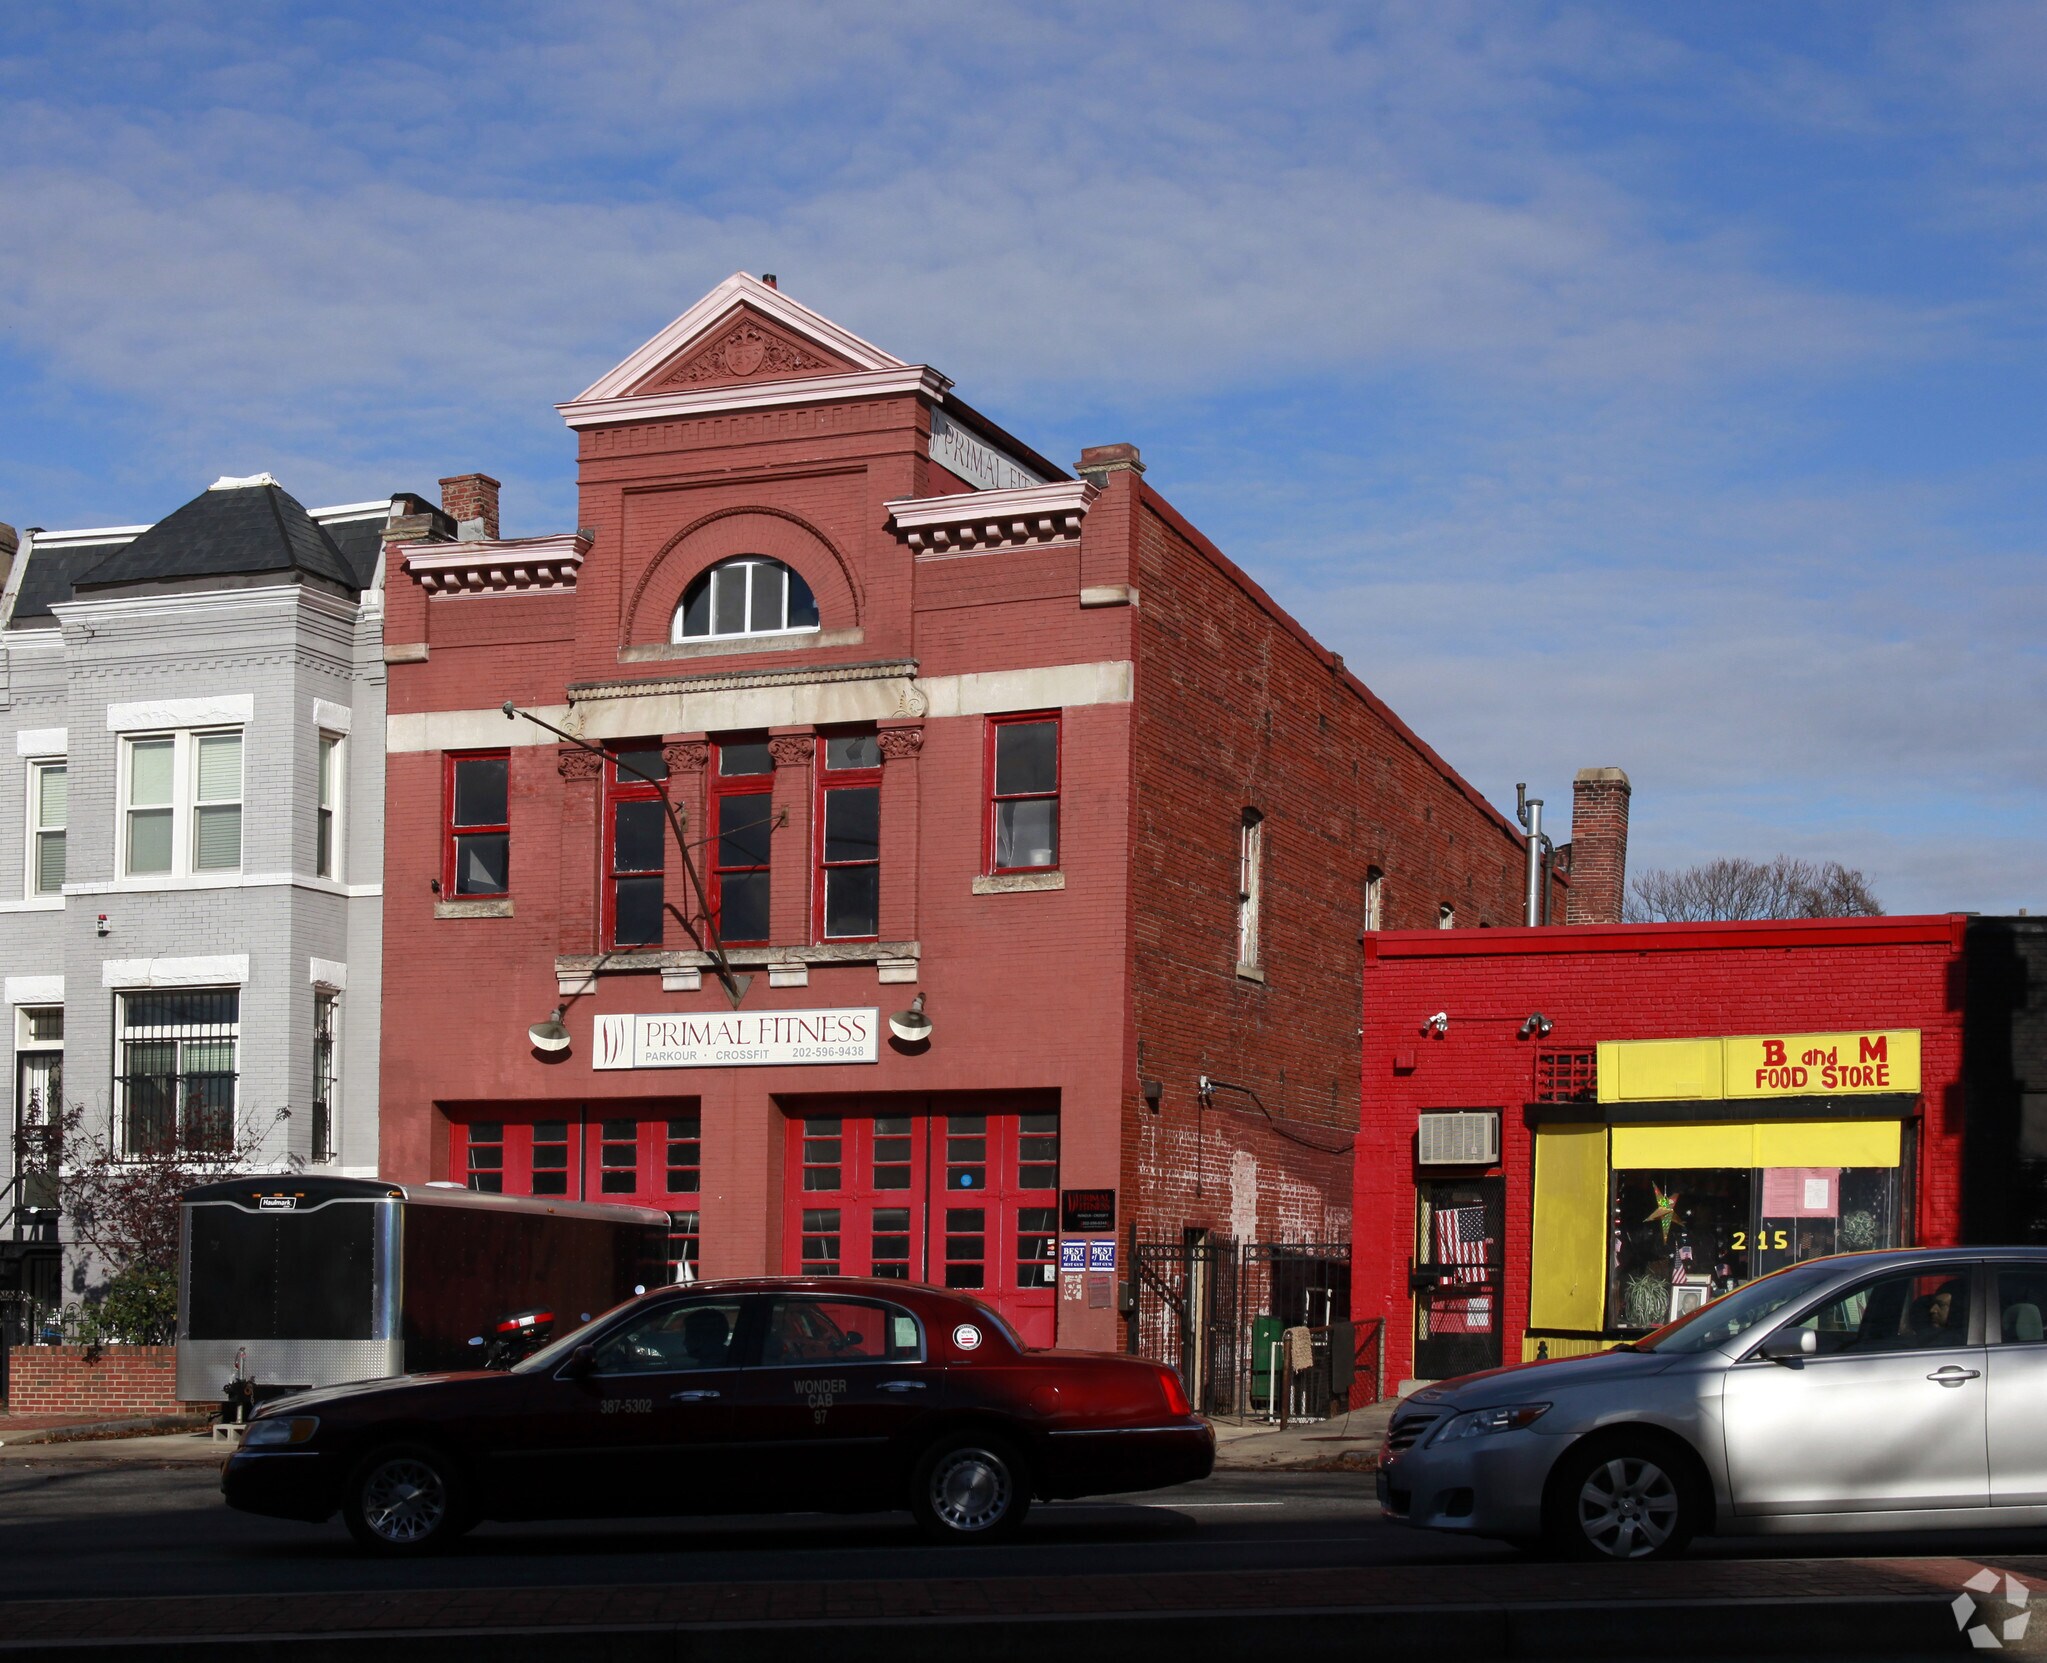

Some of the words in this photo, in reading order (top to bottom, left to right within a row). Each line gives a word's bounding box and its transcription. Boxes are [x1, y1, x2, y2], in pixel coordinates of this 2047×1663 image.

[944, 422, 999, 488] PRIMAL
[645, 1019, 751, 1047] PRIMAL
[759, 1015, 867, 1044] FITNESS
[645, 1050, 698, 1062] PARKOUR
[715, 1049, 770, 1061] CROSSFIT
[792, 1046, 864, 1059] 202-596-9438
[1762, 1039, 1788, 1067] B
[1801, 1046, 1838, 1066] and
[1859, 1035, 1887, 1064] M
[1755, 1066, 1808, 1089] FOOD
[1821, 1064, 1890, 1089] STORE
[1731, 1230, 1788, 1251] 215
[1063, 1247, 1085, 1255] BEST
[1063, 1254, 1069, 1262] of
[1092, 1247, 1114, 1255] BEST
[794, 1379, 847, 1394] WONDER
[600, 1399, 653, 1414] 387-5302
[808, 1393, 834, 1409] CAB
[814, 1409, 828, 1424] 97
